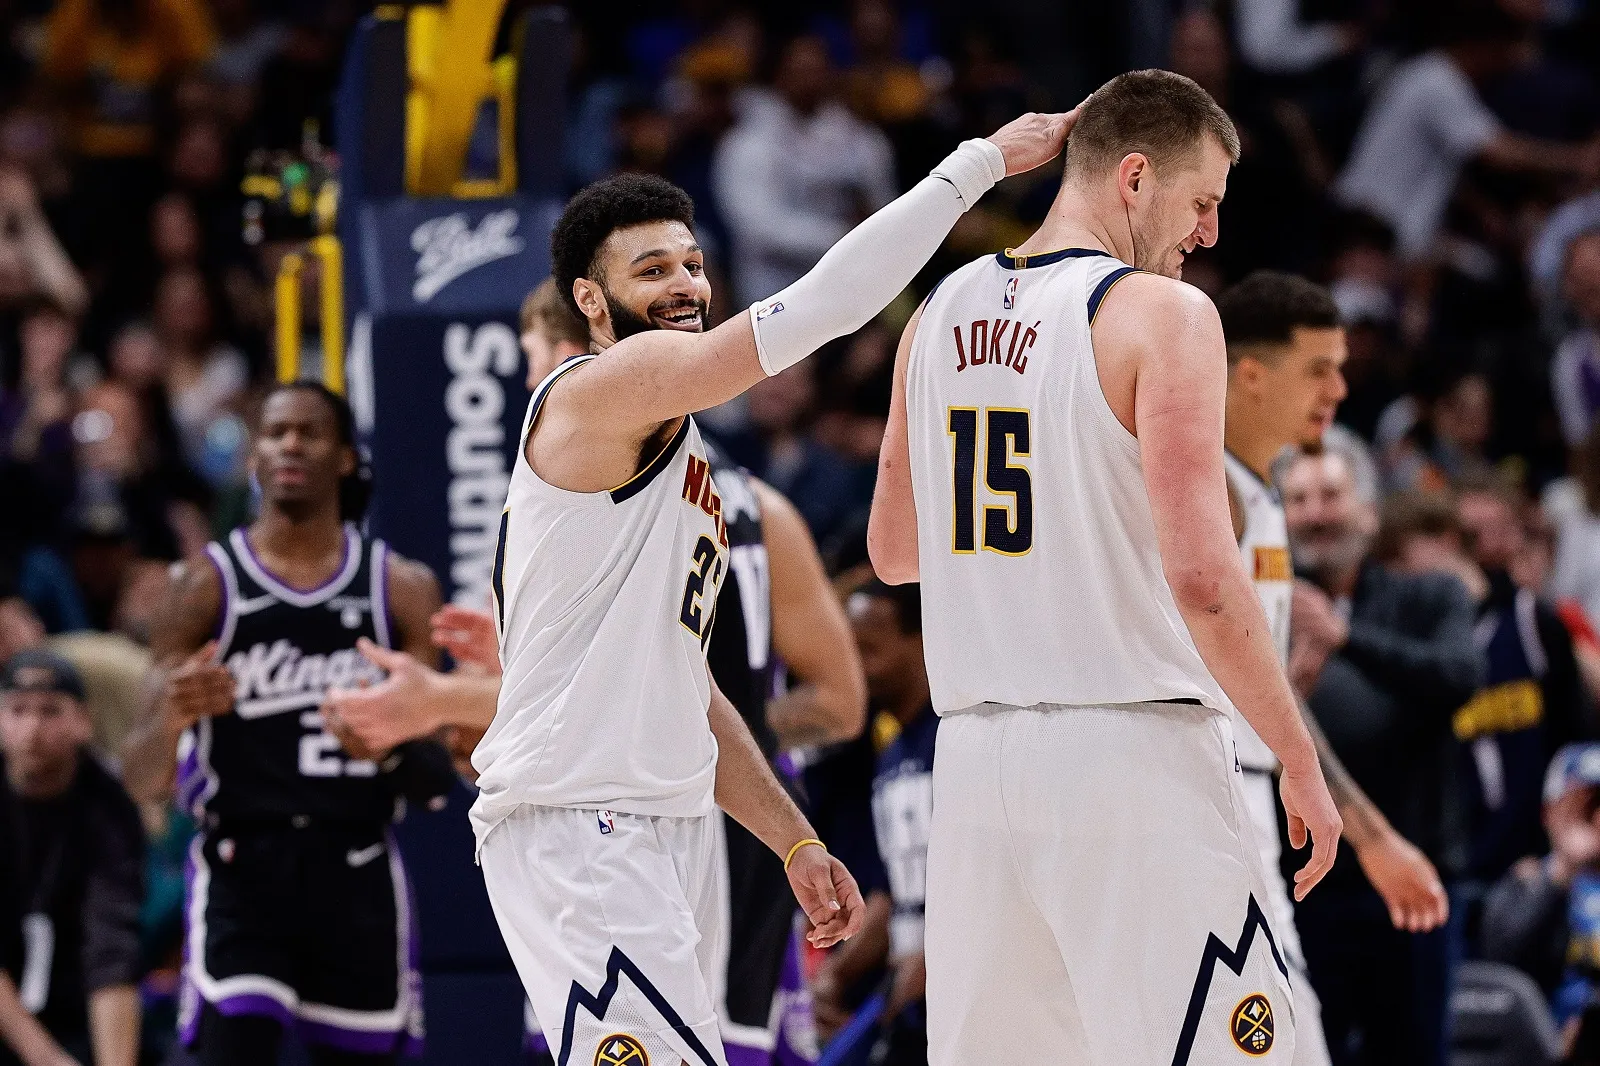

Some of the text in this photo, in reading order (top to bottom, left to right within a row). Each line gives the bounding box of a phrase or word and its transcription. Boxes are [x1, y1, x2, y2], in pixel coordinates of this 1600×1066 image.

[953, 318, 1042, 375] JOKIĆ
[946, 405, 1034, 558] 15
[298, 709, 380, 778] 2
